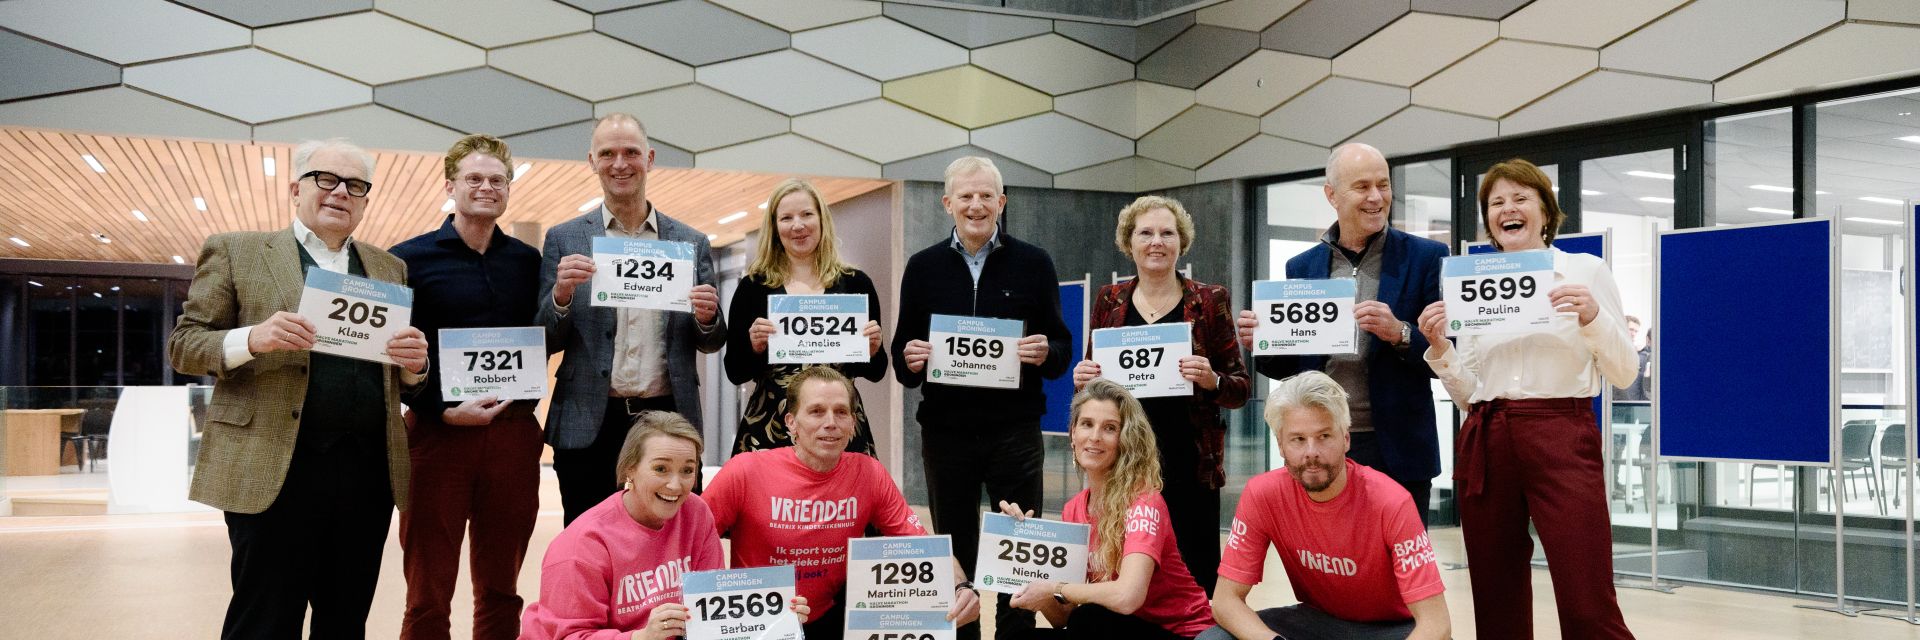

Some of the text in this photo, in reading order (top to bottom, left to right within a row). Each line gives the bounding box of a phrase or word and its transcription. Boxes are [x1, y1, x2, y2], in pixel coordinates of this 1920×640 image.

[612, 259, 674, 281] 1234
[1475, 263, 1521, 272] GRONINGEN
[343, 279, 374, 290] CAMPUS
[624, 283, 662, 292] Edward
[1461, 276, 1536, 302] 5699
[342, 286, 386, 298] GRONINGEN
[328, 298, 388, 328] 205
[1270, 302, 1338, 324] 5689
[1479, 305, 1520, 315] Paulina
[779, 316, 857, 335] 10524
[957, 325, 996, 333] GRONINGEN
[338, 326, 370, 340] Klaas
[798, 339, 840, 347] Annelies
[946, 337, 1003, 358] 1569
[464, 350, 523, 371] 7321
[1119, 347, 1164, 369] 687
[951, 360, 997, 370] Johannes
[474, 375, 516, 383] Robbert
[1129, 373, 1155, 381] Petra
[770, 522, 855, 530] BEATRIX KINDERZIEKENHUIS
[1015, 522, 1043, 530] CAMPUS
[1014, 528, 1056, 538] GRONINGEN
[790, 547, 819, 556] sport
[998, 539, 1067, 568] 2598
[770, 555, 845, 566] het zieke kind!
[871, 562, 934, 584] 1298
[1013, 567, 1049, 579] Nienke
[716, 579, 763, 588] GRONINGEN
[868, 588, 937, 598] Martini Plaza
[696, 592, 784, 621] 12569
[720, 623, 765, 634] Barbara
